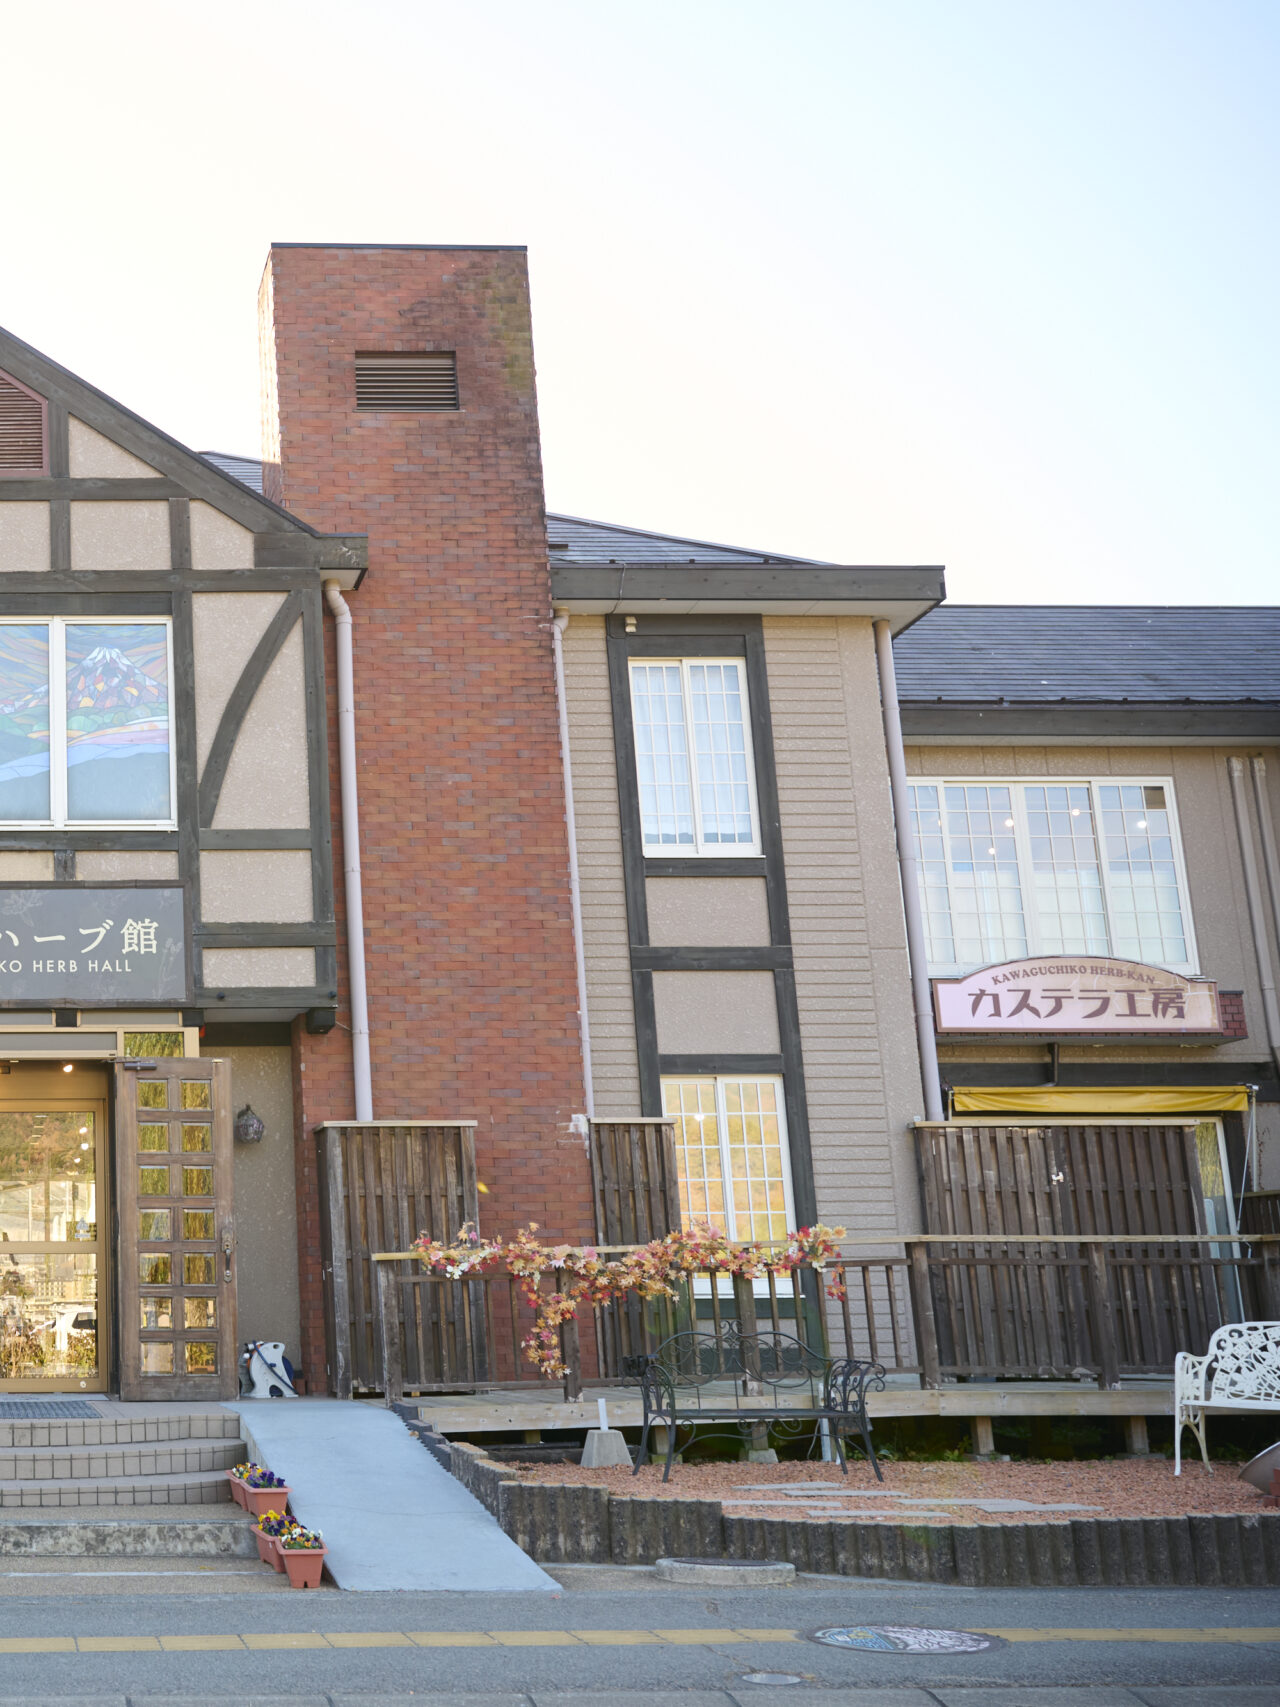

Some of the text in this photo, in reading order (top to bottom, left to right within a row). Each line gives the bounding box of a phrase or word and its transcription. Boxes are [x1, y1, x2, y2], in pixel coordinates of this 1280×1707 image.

[32, 960, 79, 973] HERB
[87, 959, 133, 973] HALL
[991, 964, 1156, 986] KAWAGUCHIKO HERB-KAN
[968, 987, 1186, 1019] カステラ工房
